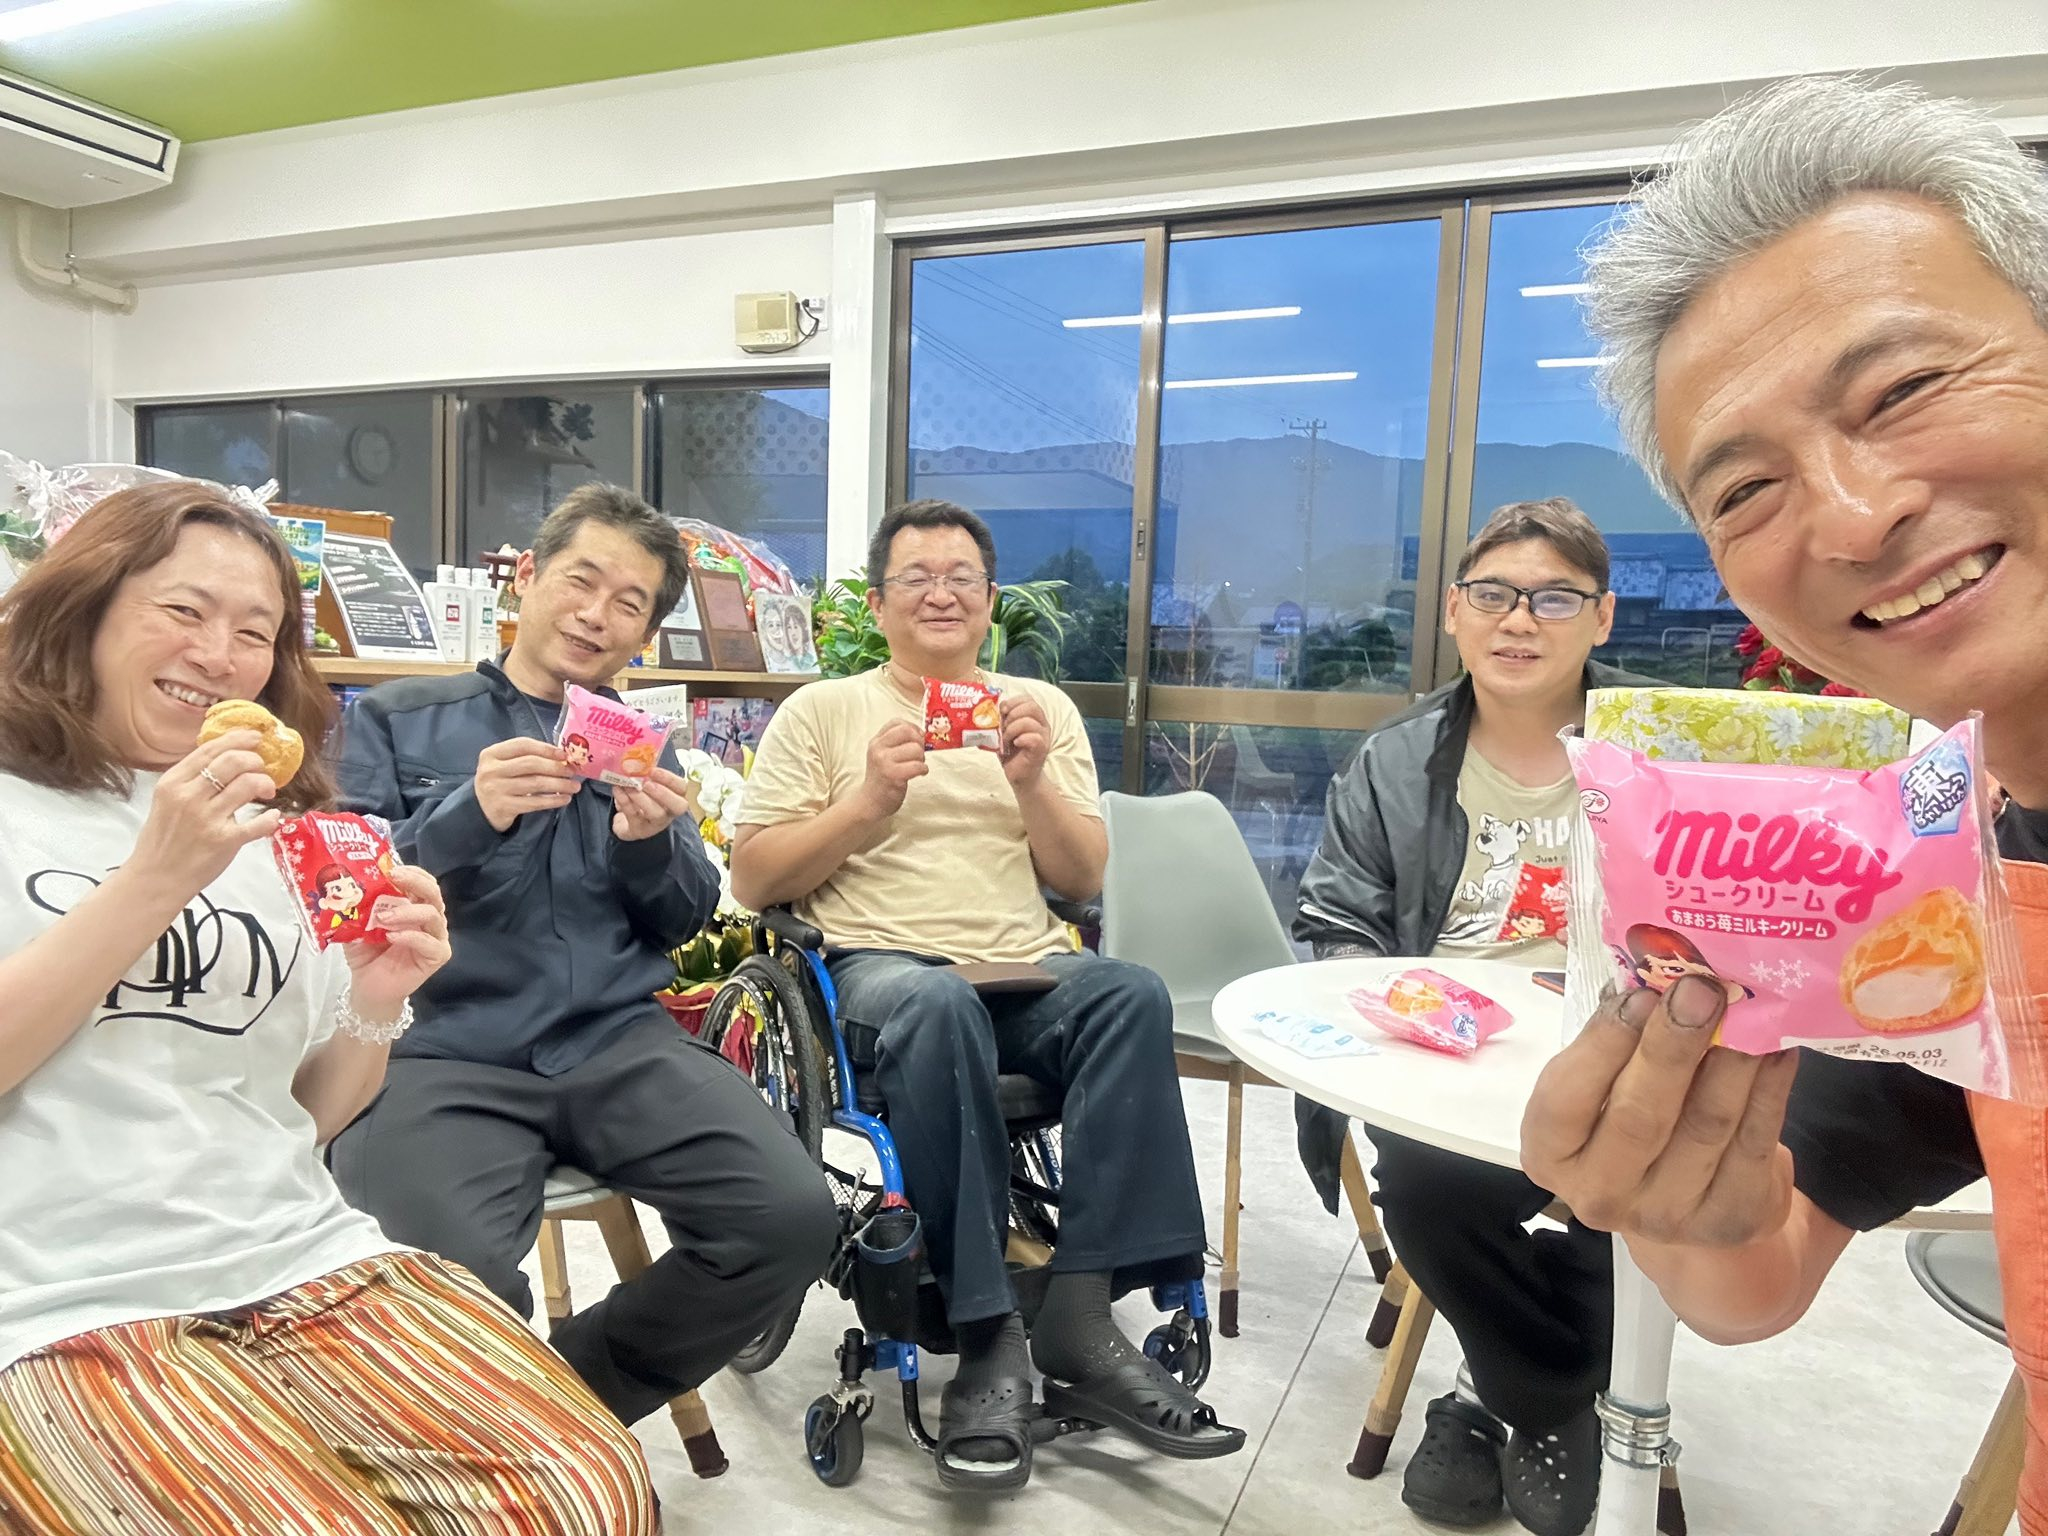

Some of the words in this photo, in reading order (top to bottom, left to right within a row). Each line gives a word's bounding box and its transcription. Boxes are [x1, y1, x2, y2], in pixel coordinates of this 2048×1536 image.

[1665, 880, 1826, 911] シュークリーム
[1671, 909, 1828, 937] あまおう苺ミルキークリーム
